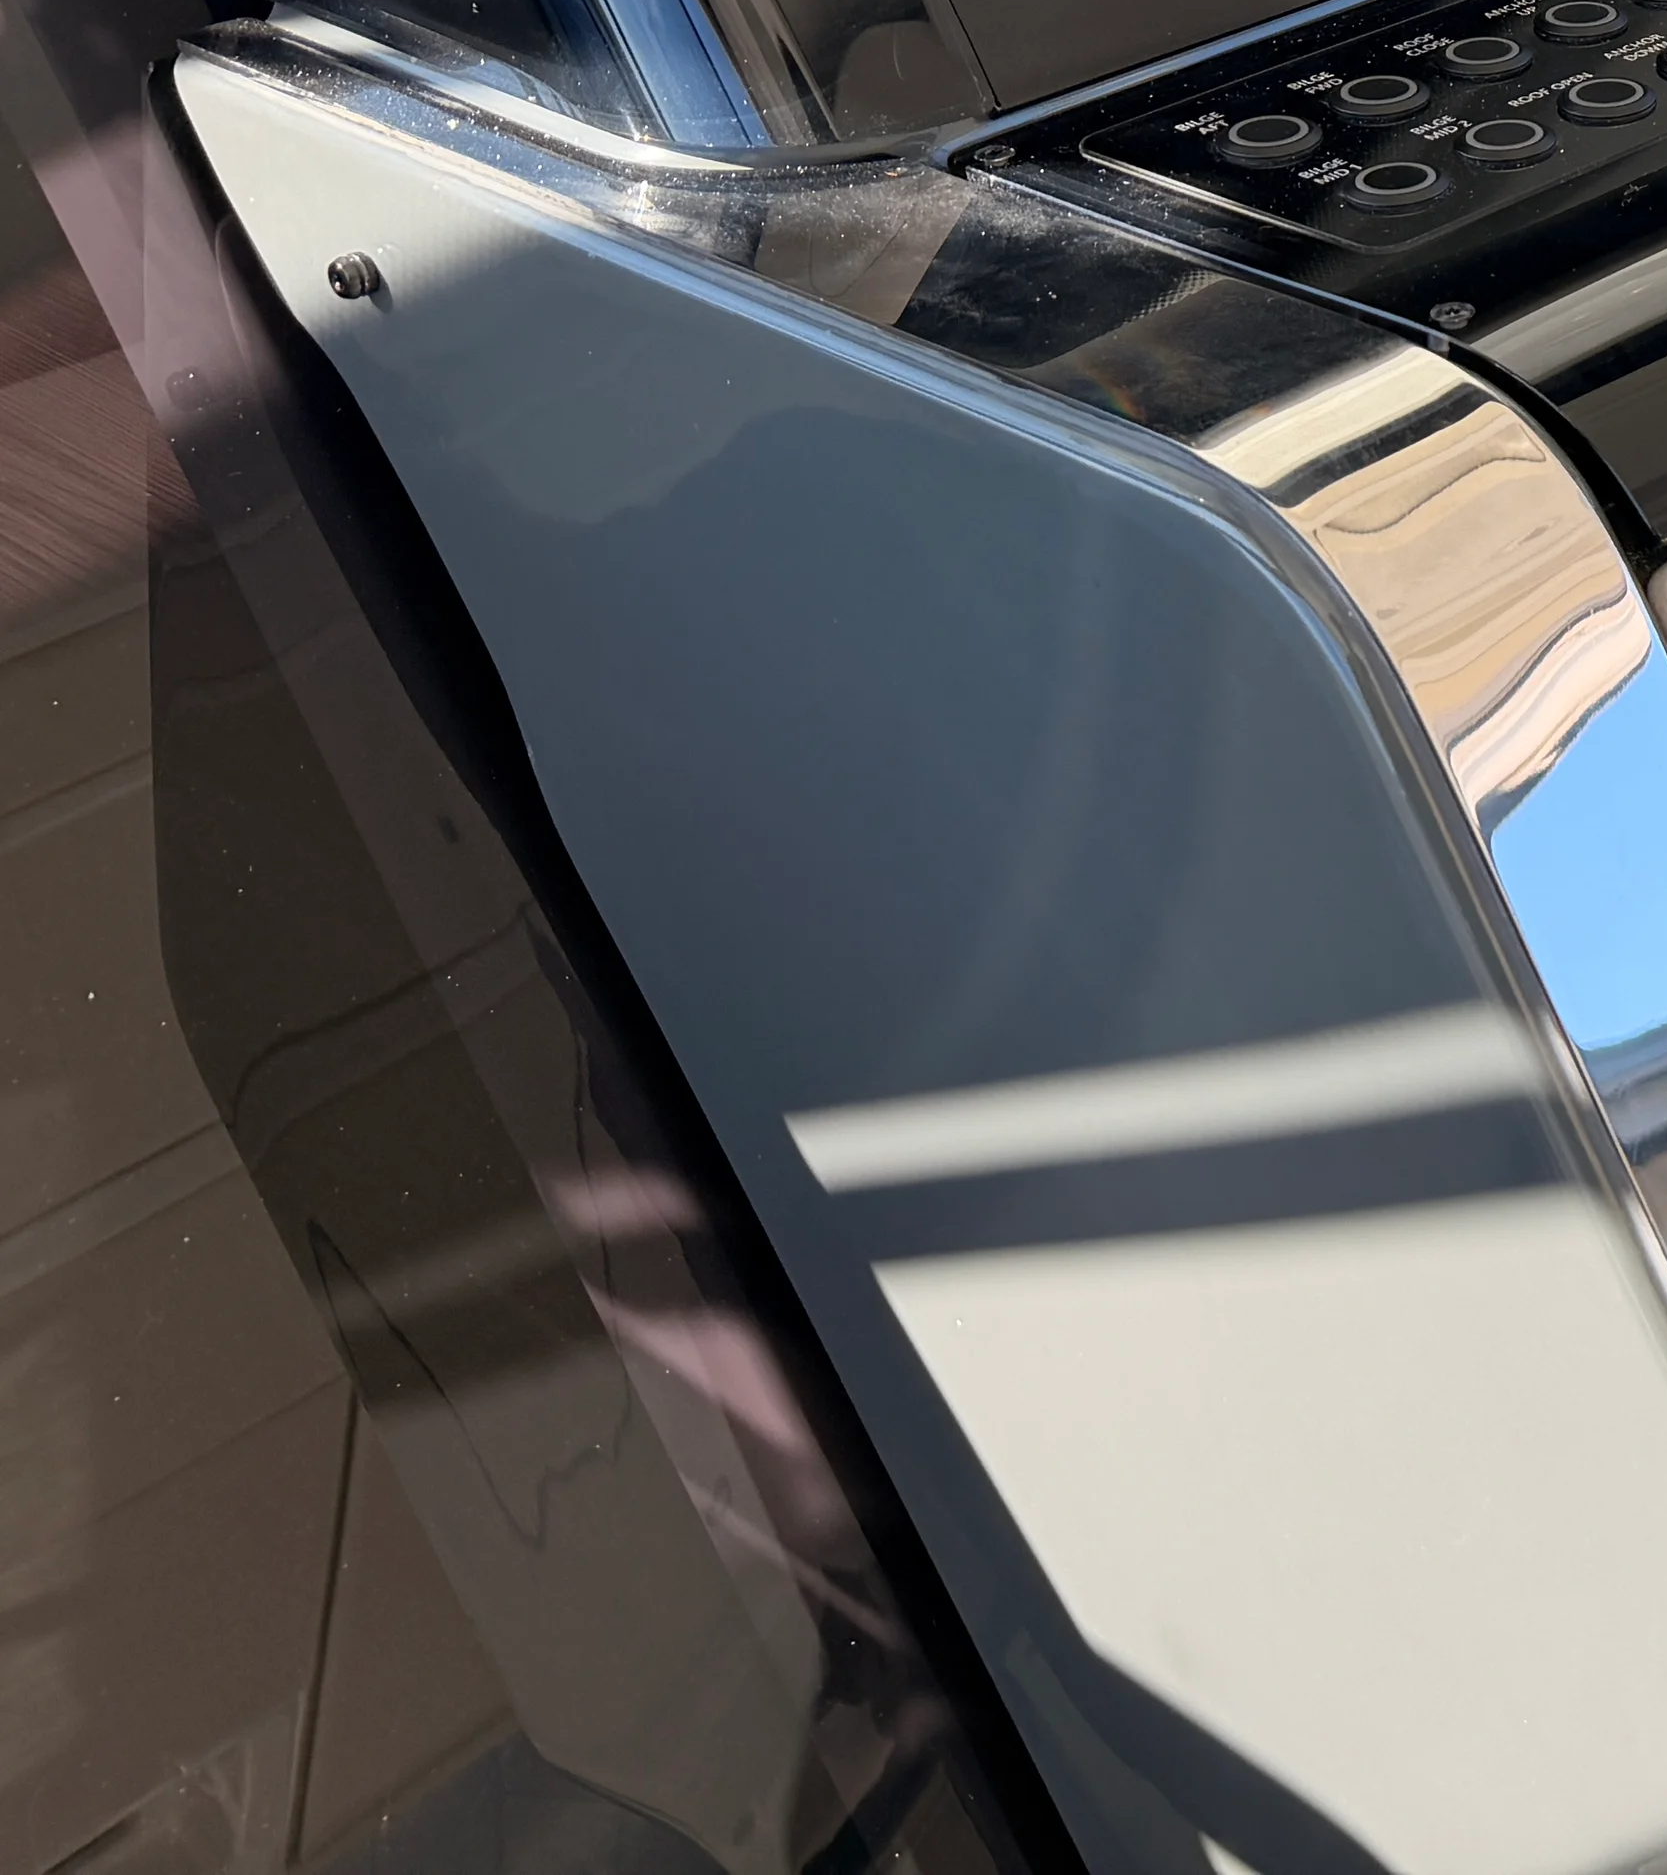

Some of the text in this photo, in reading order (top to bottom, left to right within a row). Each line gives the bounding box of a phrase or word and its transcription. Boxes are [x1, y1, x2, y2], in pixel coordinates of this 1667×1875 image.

[1516, 5, 1538, 17] UP
[1392, 33, 1434, 51] ROOF
[1406, 37, 1455, 57] CLOSE
[1603, 33, 1665, 60] ANCHOR
[1286, 71, 1335, 91] BILGE
[1304, 78, 1344, 95] FWD
[1507, 71, 1594, 108] ROOF OPEN
[1174, 111, 1226, 132] BILGE
[1199, 121, 1228, 135] AFT
[1410, 114, 1457, 135] BILGE
[1424, 119, 1473, 141] MID 2
[1298, 157, 1348, 180] BILGE
[1313, 163, 1363, 185] MID 1
